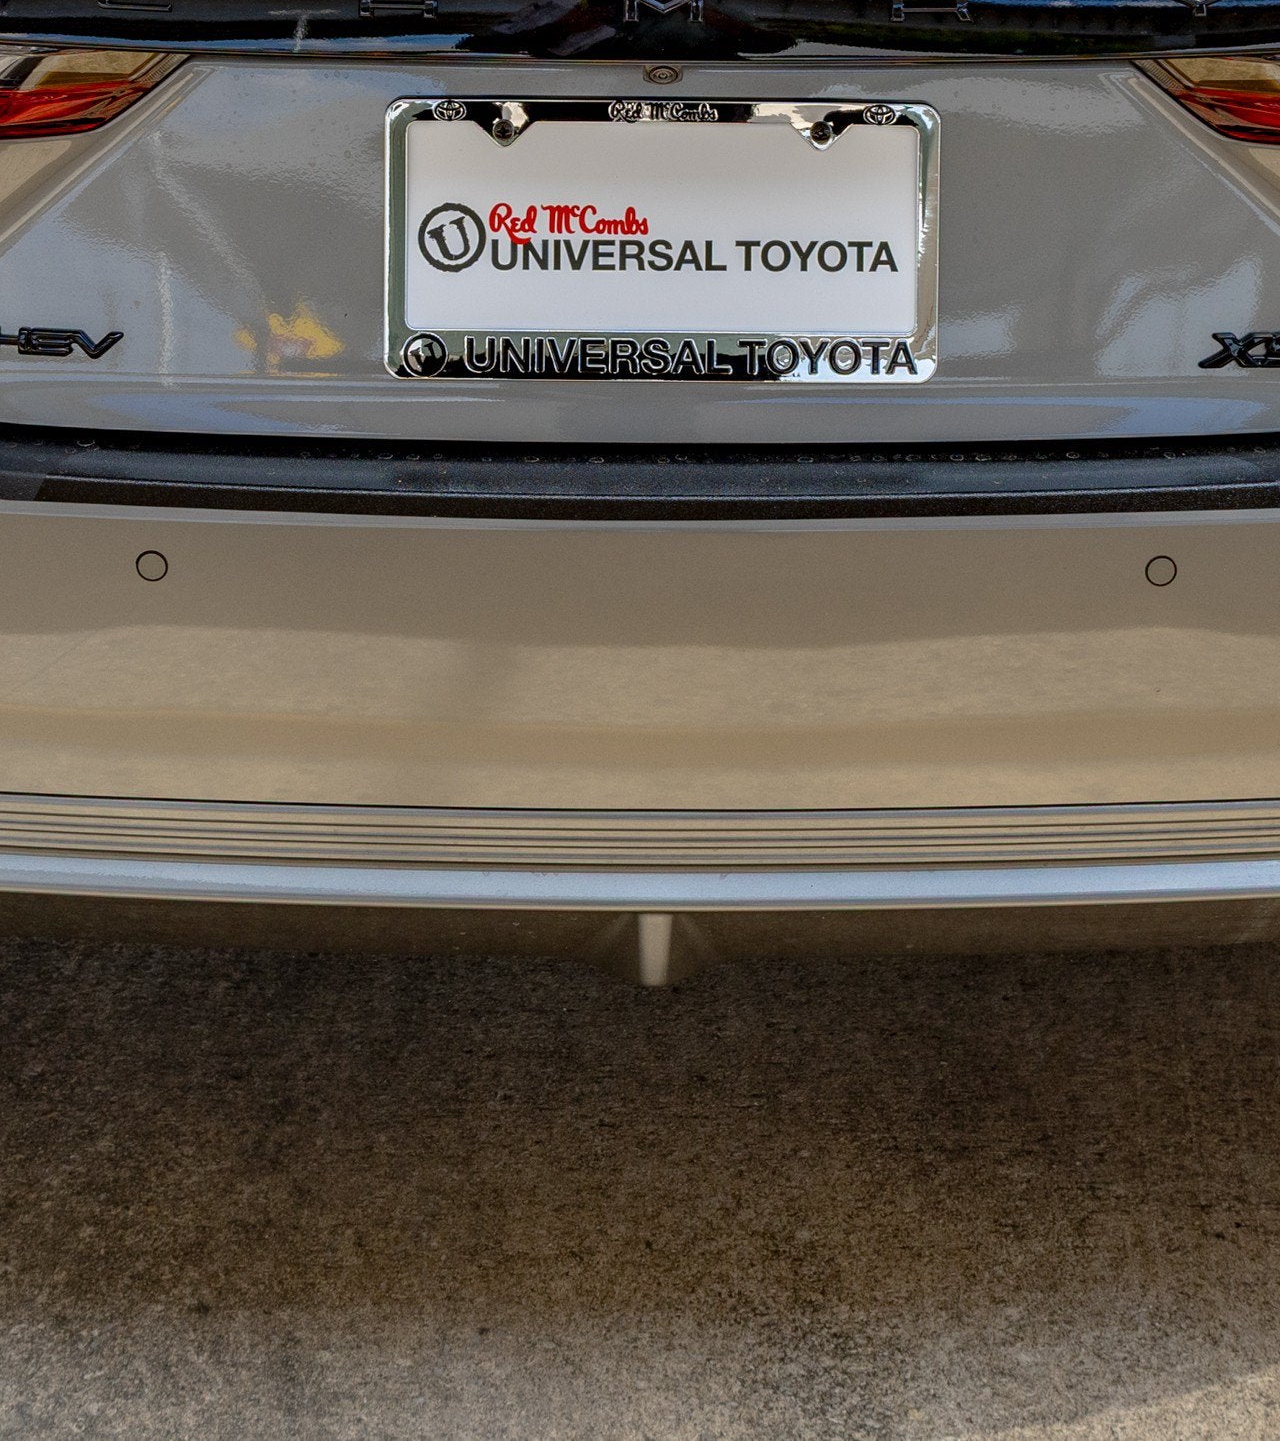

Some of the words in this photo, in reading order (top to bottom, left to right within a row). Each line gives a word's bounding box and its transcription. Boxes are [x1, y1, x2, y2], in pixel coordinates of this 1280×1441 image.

[608, 99, 642, 123] Red
[489, 202, 538, 245] Red
[541, 203, 649, 236] McCombs
[491, 238, 727, 273] UNIVERSAL
[735, 240, 899, 273] TOYOTA
[464, 335, 732, 375] UNIVERSAL
[737, 337, 919, 376] TOYOTA
